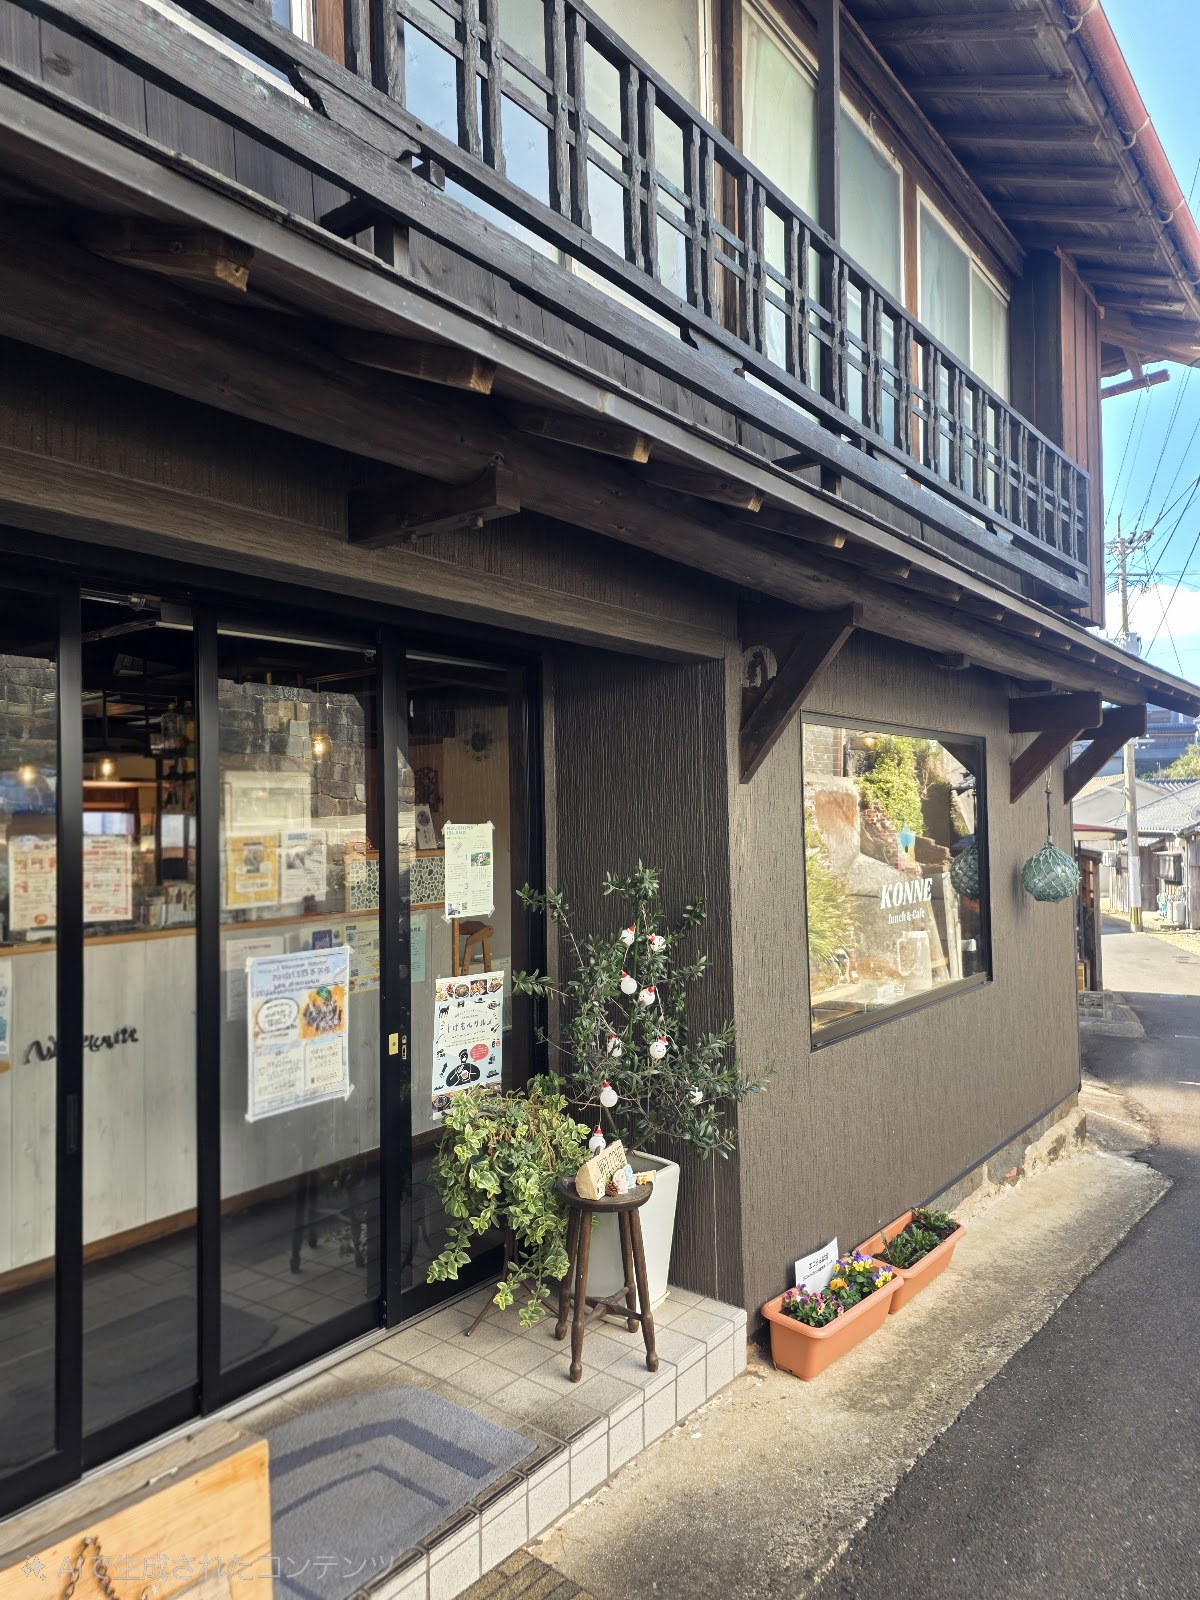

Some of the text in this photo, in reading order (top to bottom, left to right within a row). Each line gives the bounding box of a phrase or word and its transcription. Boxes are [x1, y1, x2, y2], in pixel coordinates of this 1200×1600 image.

[880, 878, 932, 909] KONNE
[888, 911, 906, 925] lunch
[907, 912, 912, 921] &
